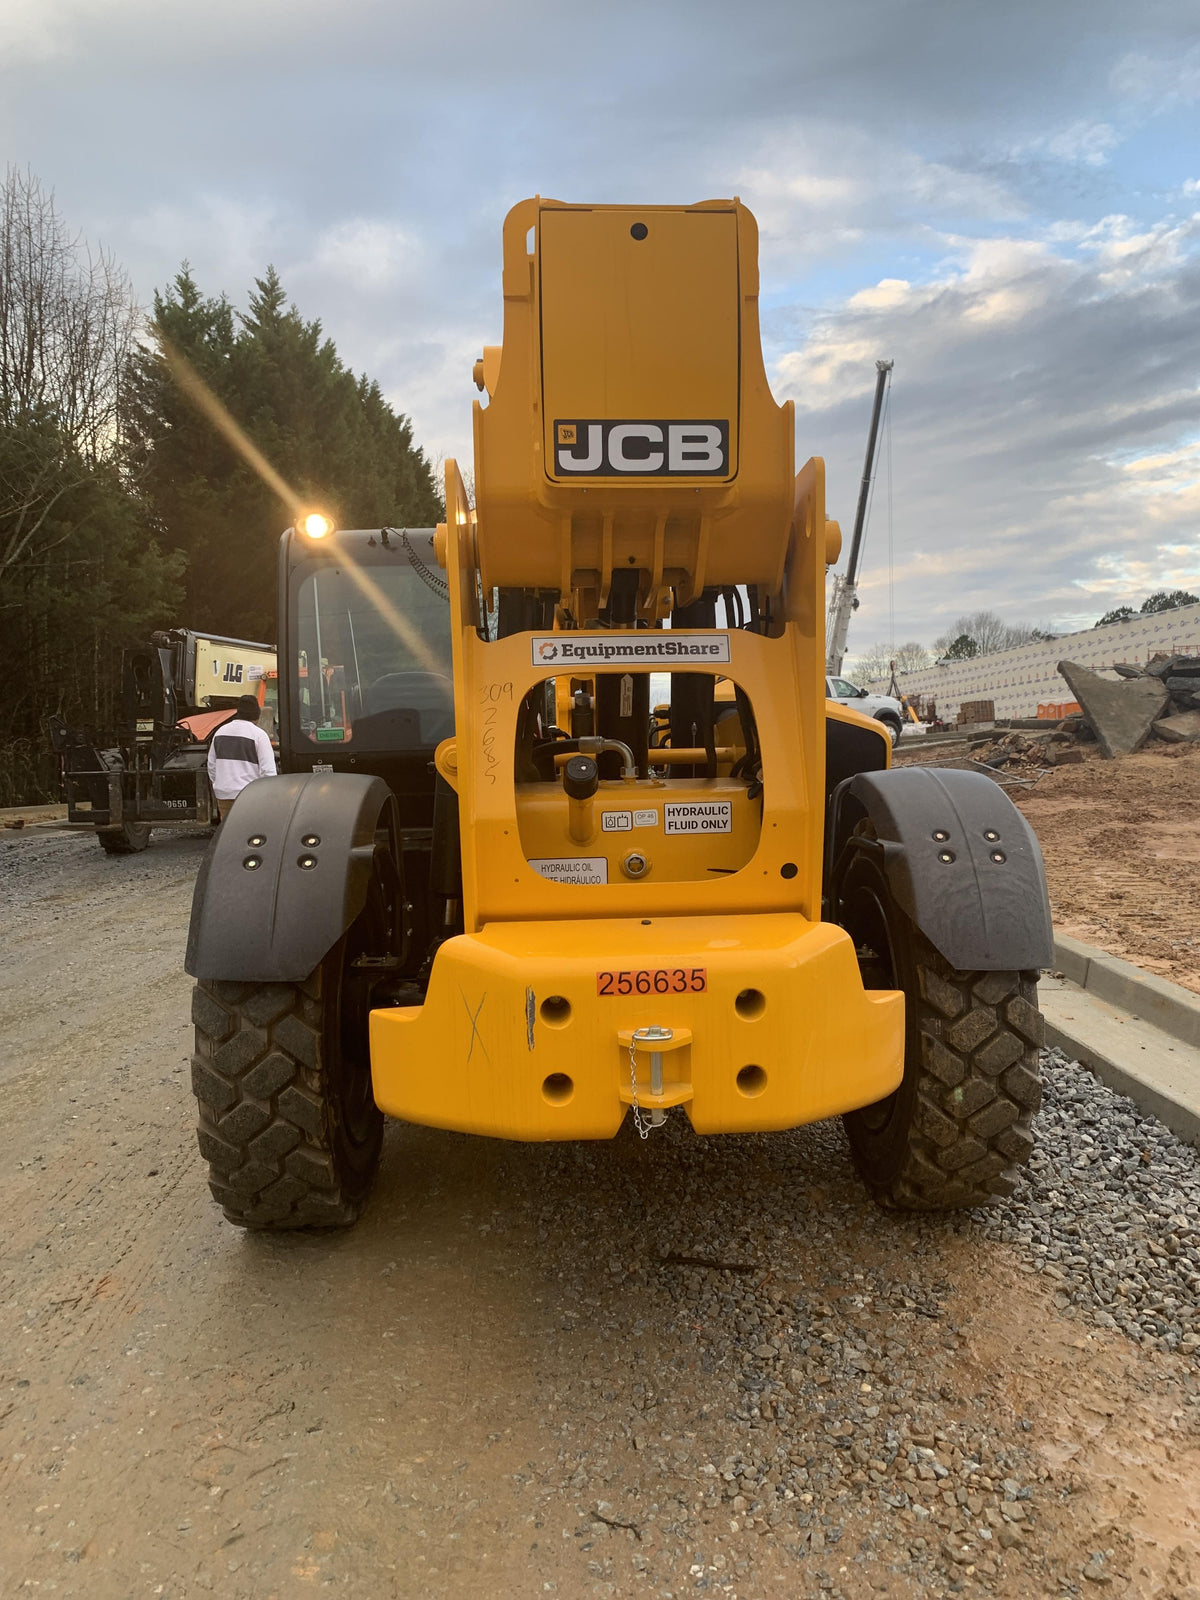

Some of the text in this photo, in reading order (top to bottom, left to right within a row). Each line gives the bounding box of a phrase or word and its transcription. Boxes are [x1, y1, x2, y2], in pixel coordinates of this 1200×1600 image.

[558, 424, 724, 472] JCB
[561, 642, 720, 659] EquipmentShare
[223, 663, 243, 683] JLG
[479, 682, 513, 705] 309
[667, 805, 729, 817] HYDRAULIC
[668, 819, 729, 830] FLUID ONLY
[541, 862, 593, 873] HYDRAULIC OIL
[599, 968, 705, 995] 256635
